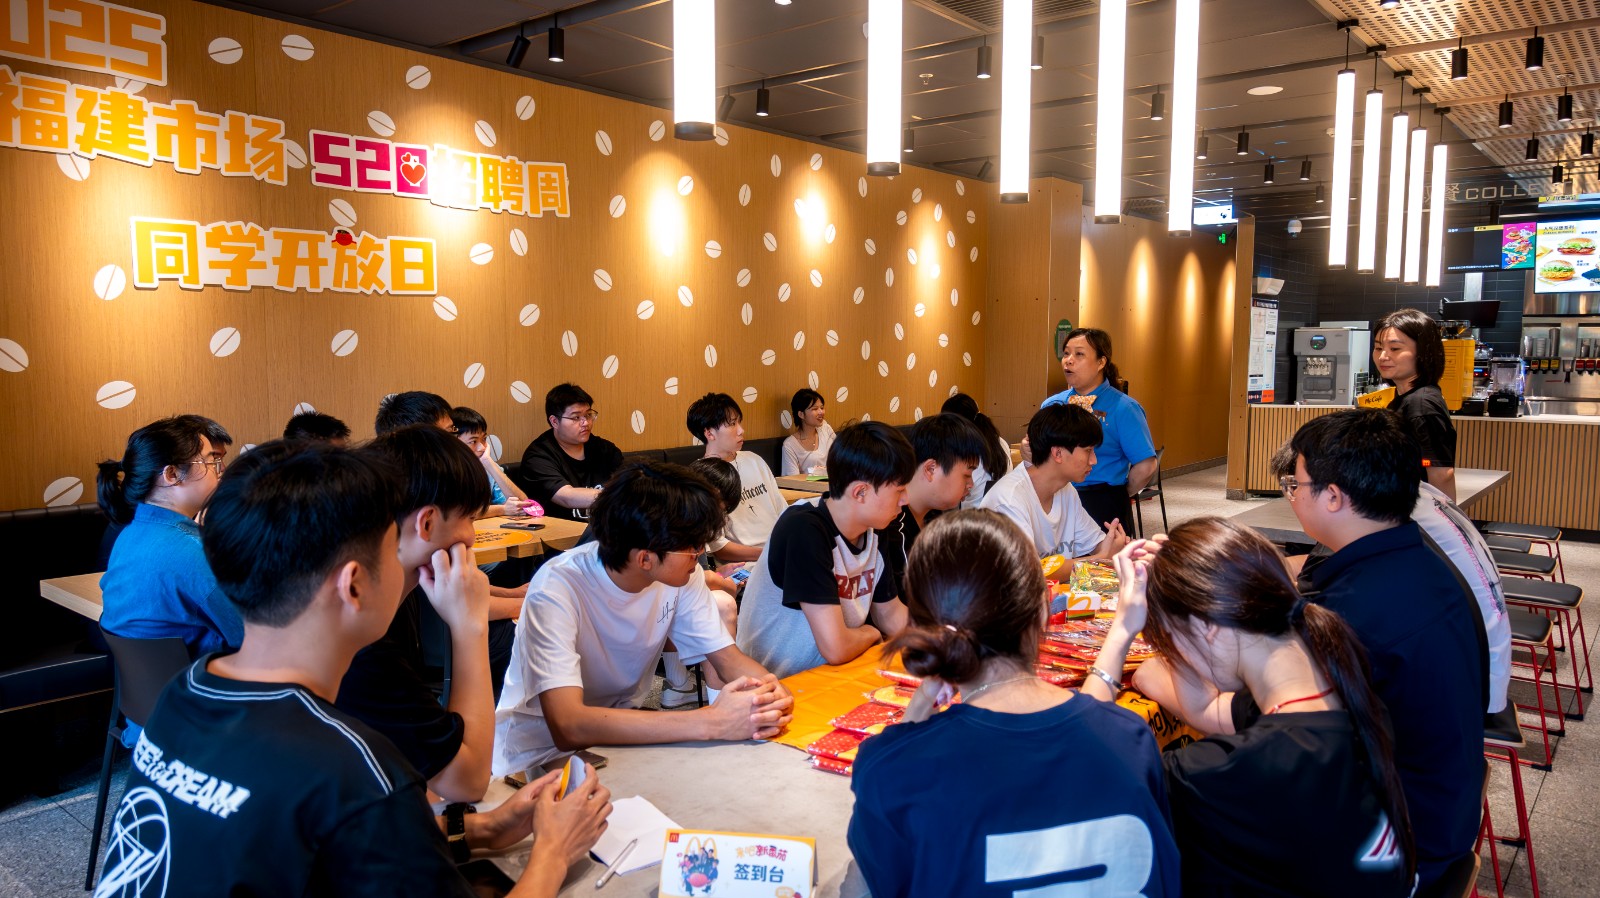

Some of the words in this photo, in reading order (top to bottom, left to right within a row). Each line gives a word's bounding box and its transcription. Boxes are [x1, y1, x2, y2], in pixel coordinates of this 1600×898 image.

[135, 221, 435, 291] 同学开放日
[734, 863, 784, 883] 签到台
